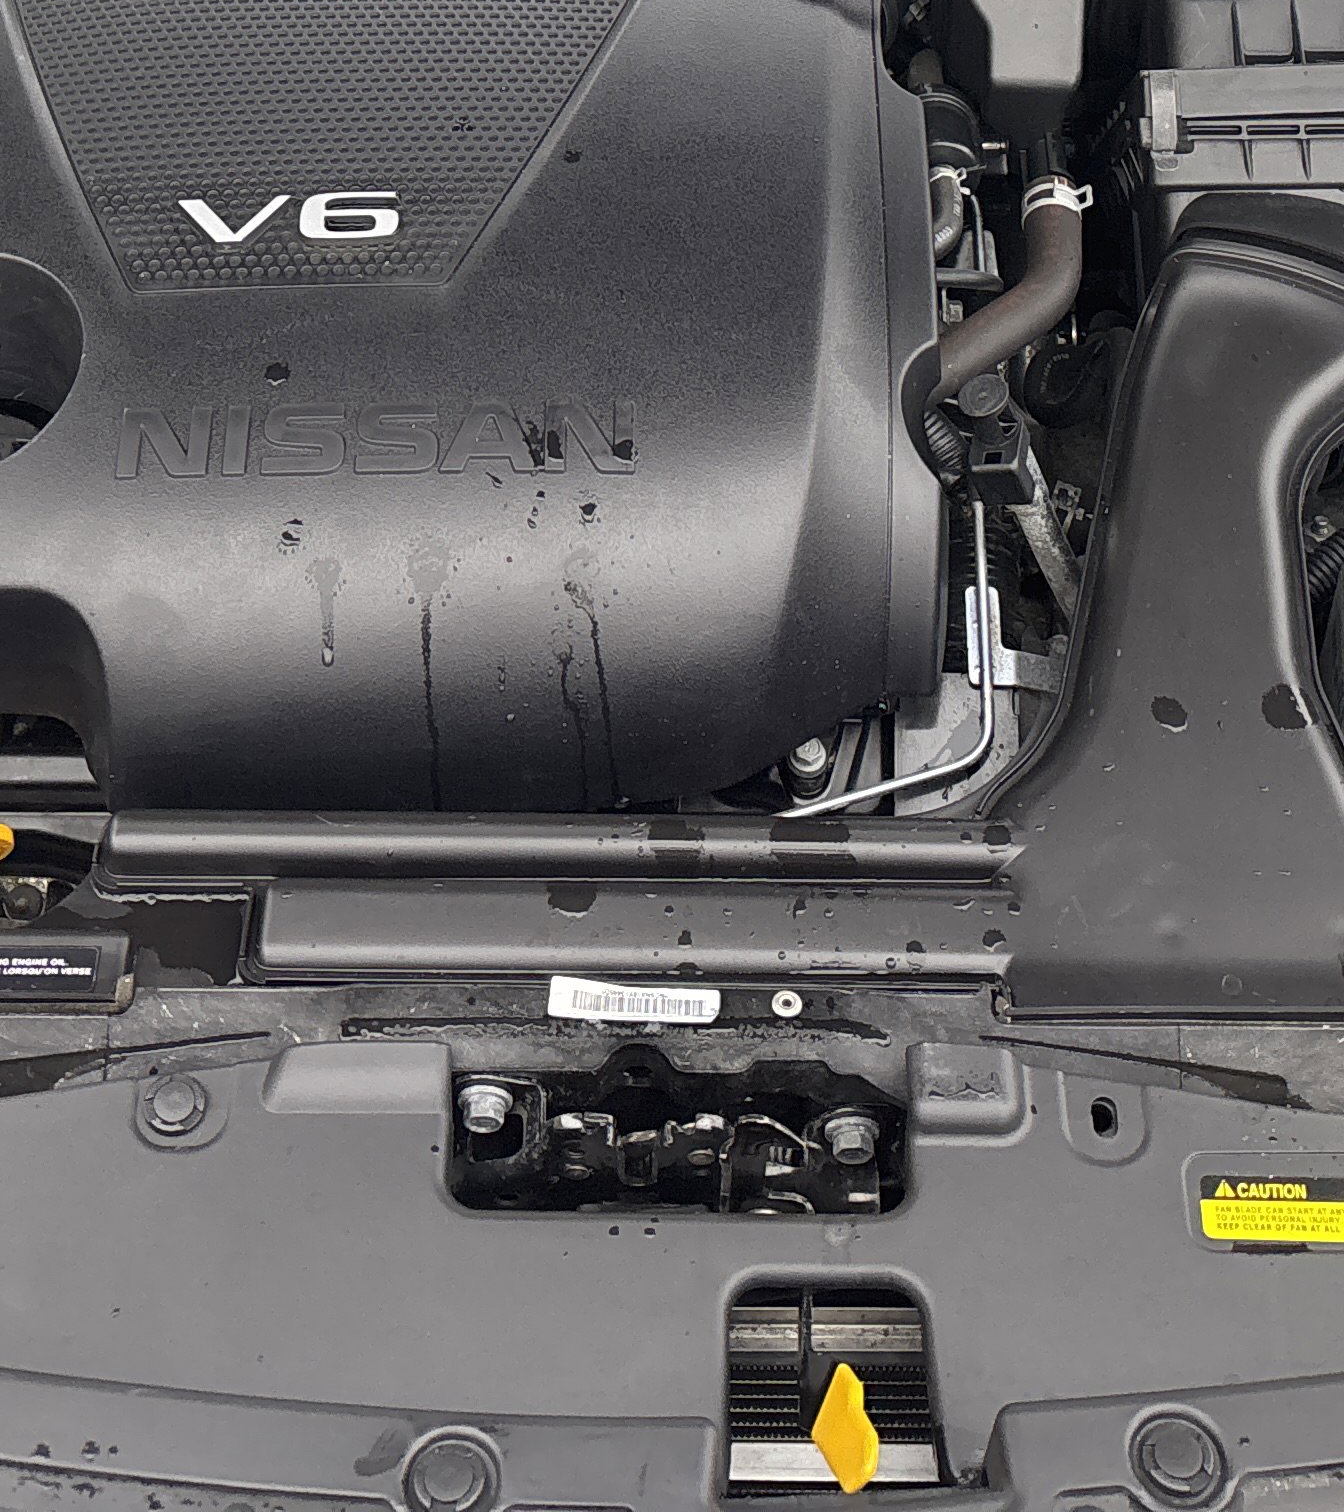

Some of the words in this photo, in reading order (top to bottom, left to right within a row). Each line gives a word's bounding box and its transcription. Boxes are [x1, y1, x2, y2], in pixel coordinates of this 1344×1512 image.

[178, 190, 402, 245] V6
[114, 398, 636, 479] NISSAN
[12, 958, 48, 966] ENGINE
[1237, 1182, 1307, 1199] CAUTION
[1234, 1206, 1261, 1214] BLADE
[1286, 1207, 1314, 1215] START
[1260, 1215, 1306, 1223] PERSONAL
[1243, 1223, 1272, 1231] CLEAR
[1324, 1225, 1340, 1233] ALL
